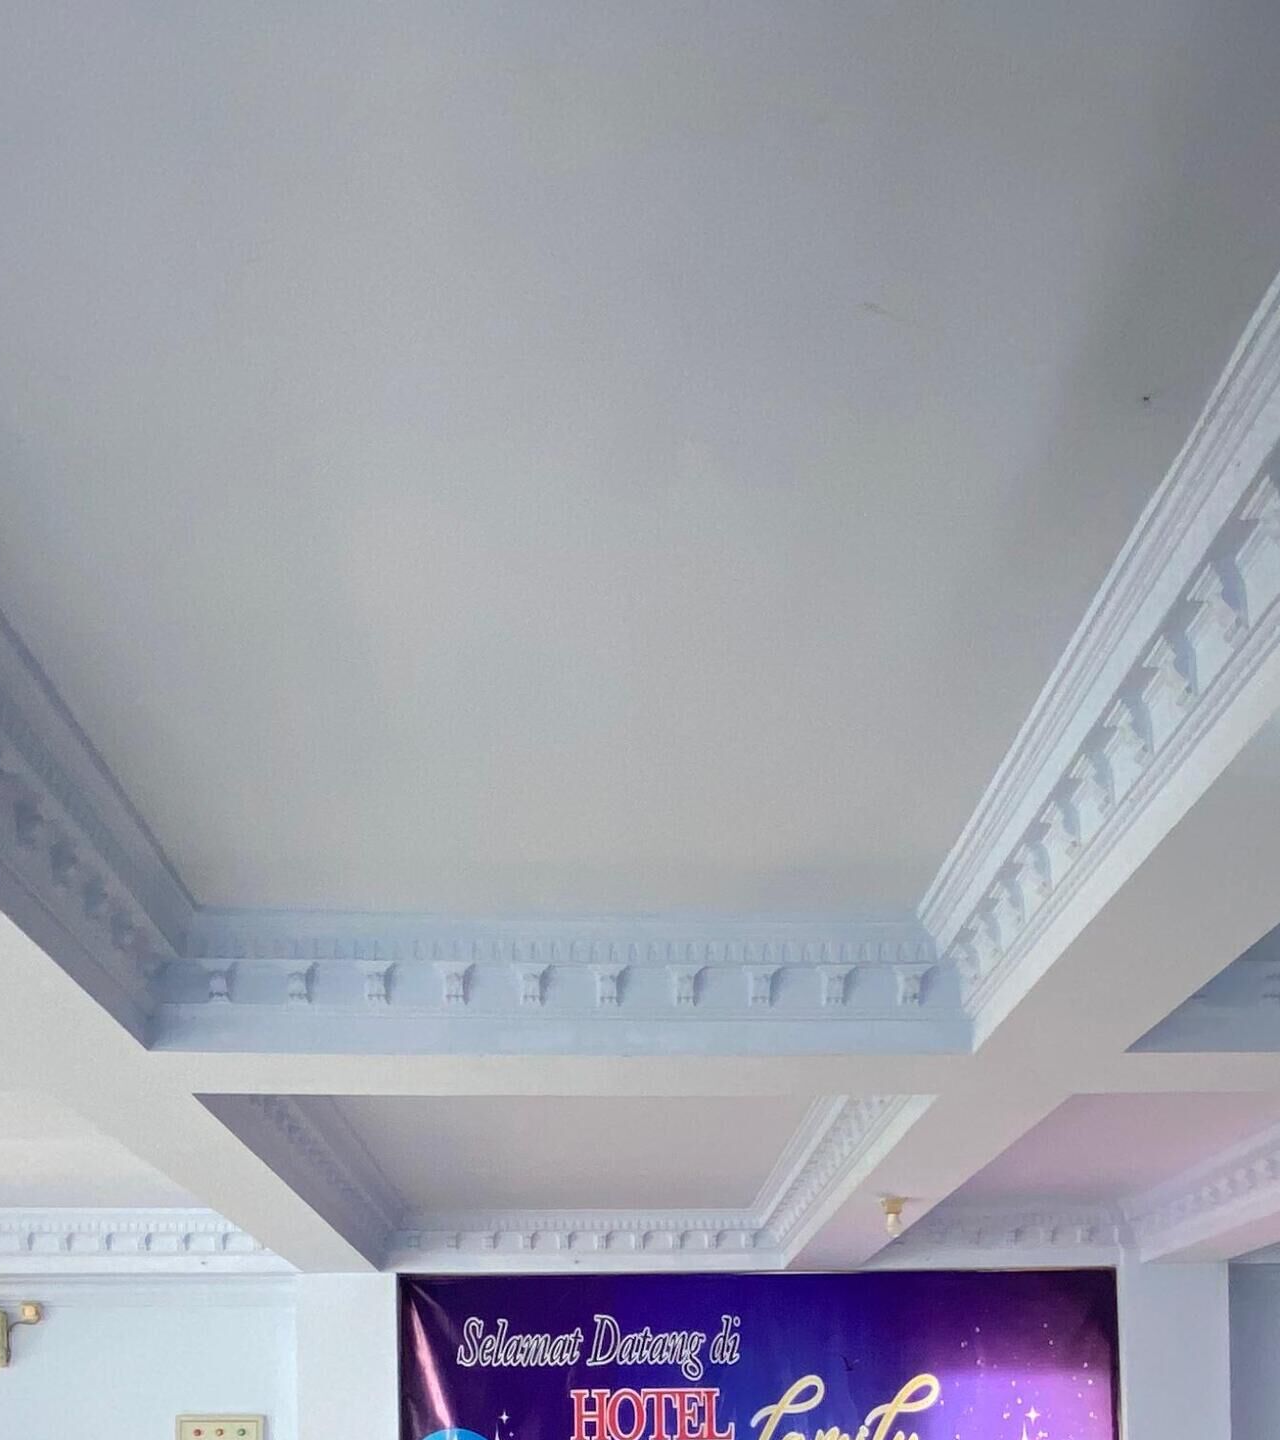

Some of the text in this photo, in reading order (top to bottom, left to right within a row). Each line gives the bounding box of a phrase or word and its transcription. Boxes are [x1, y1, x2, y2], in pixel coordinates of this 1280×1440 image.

[457, 1314, 741, 1381] Selamat Datang di
